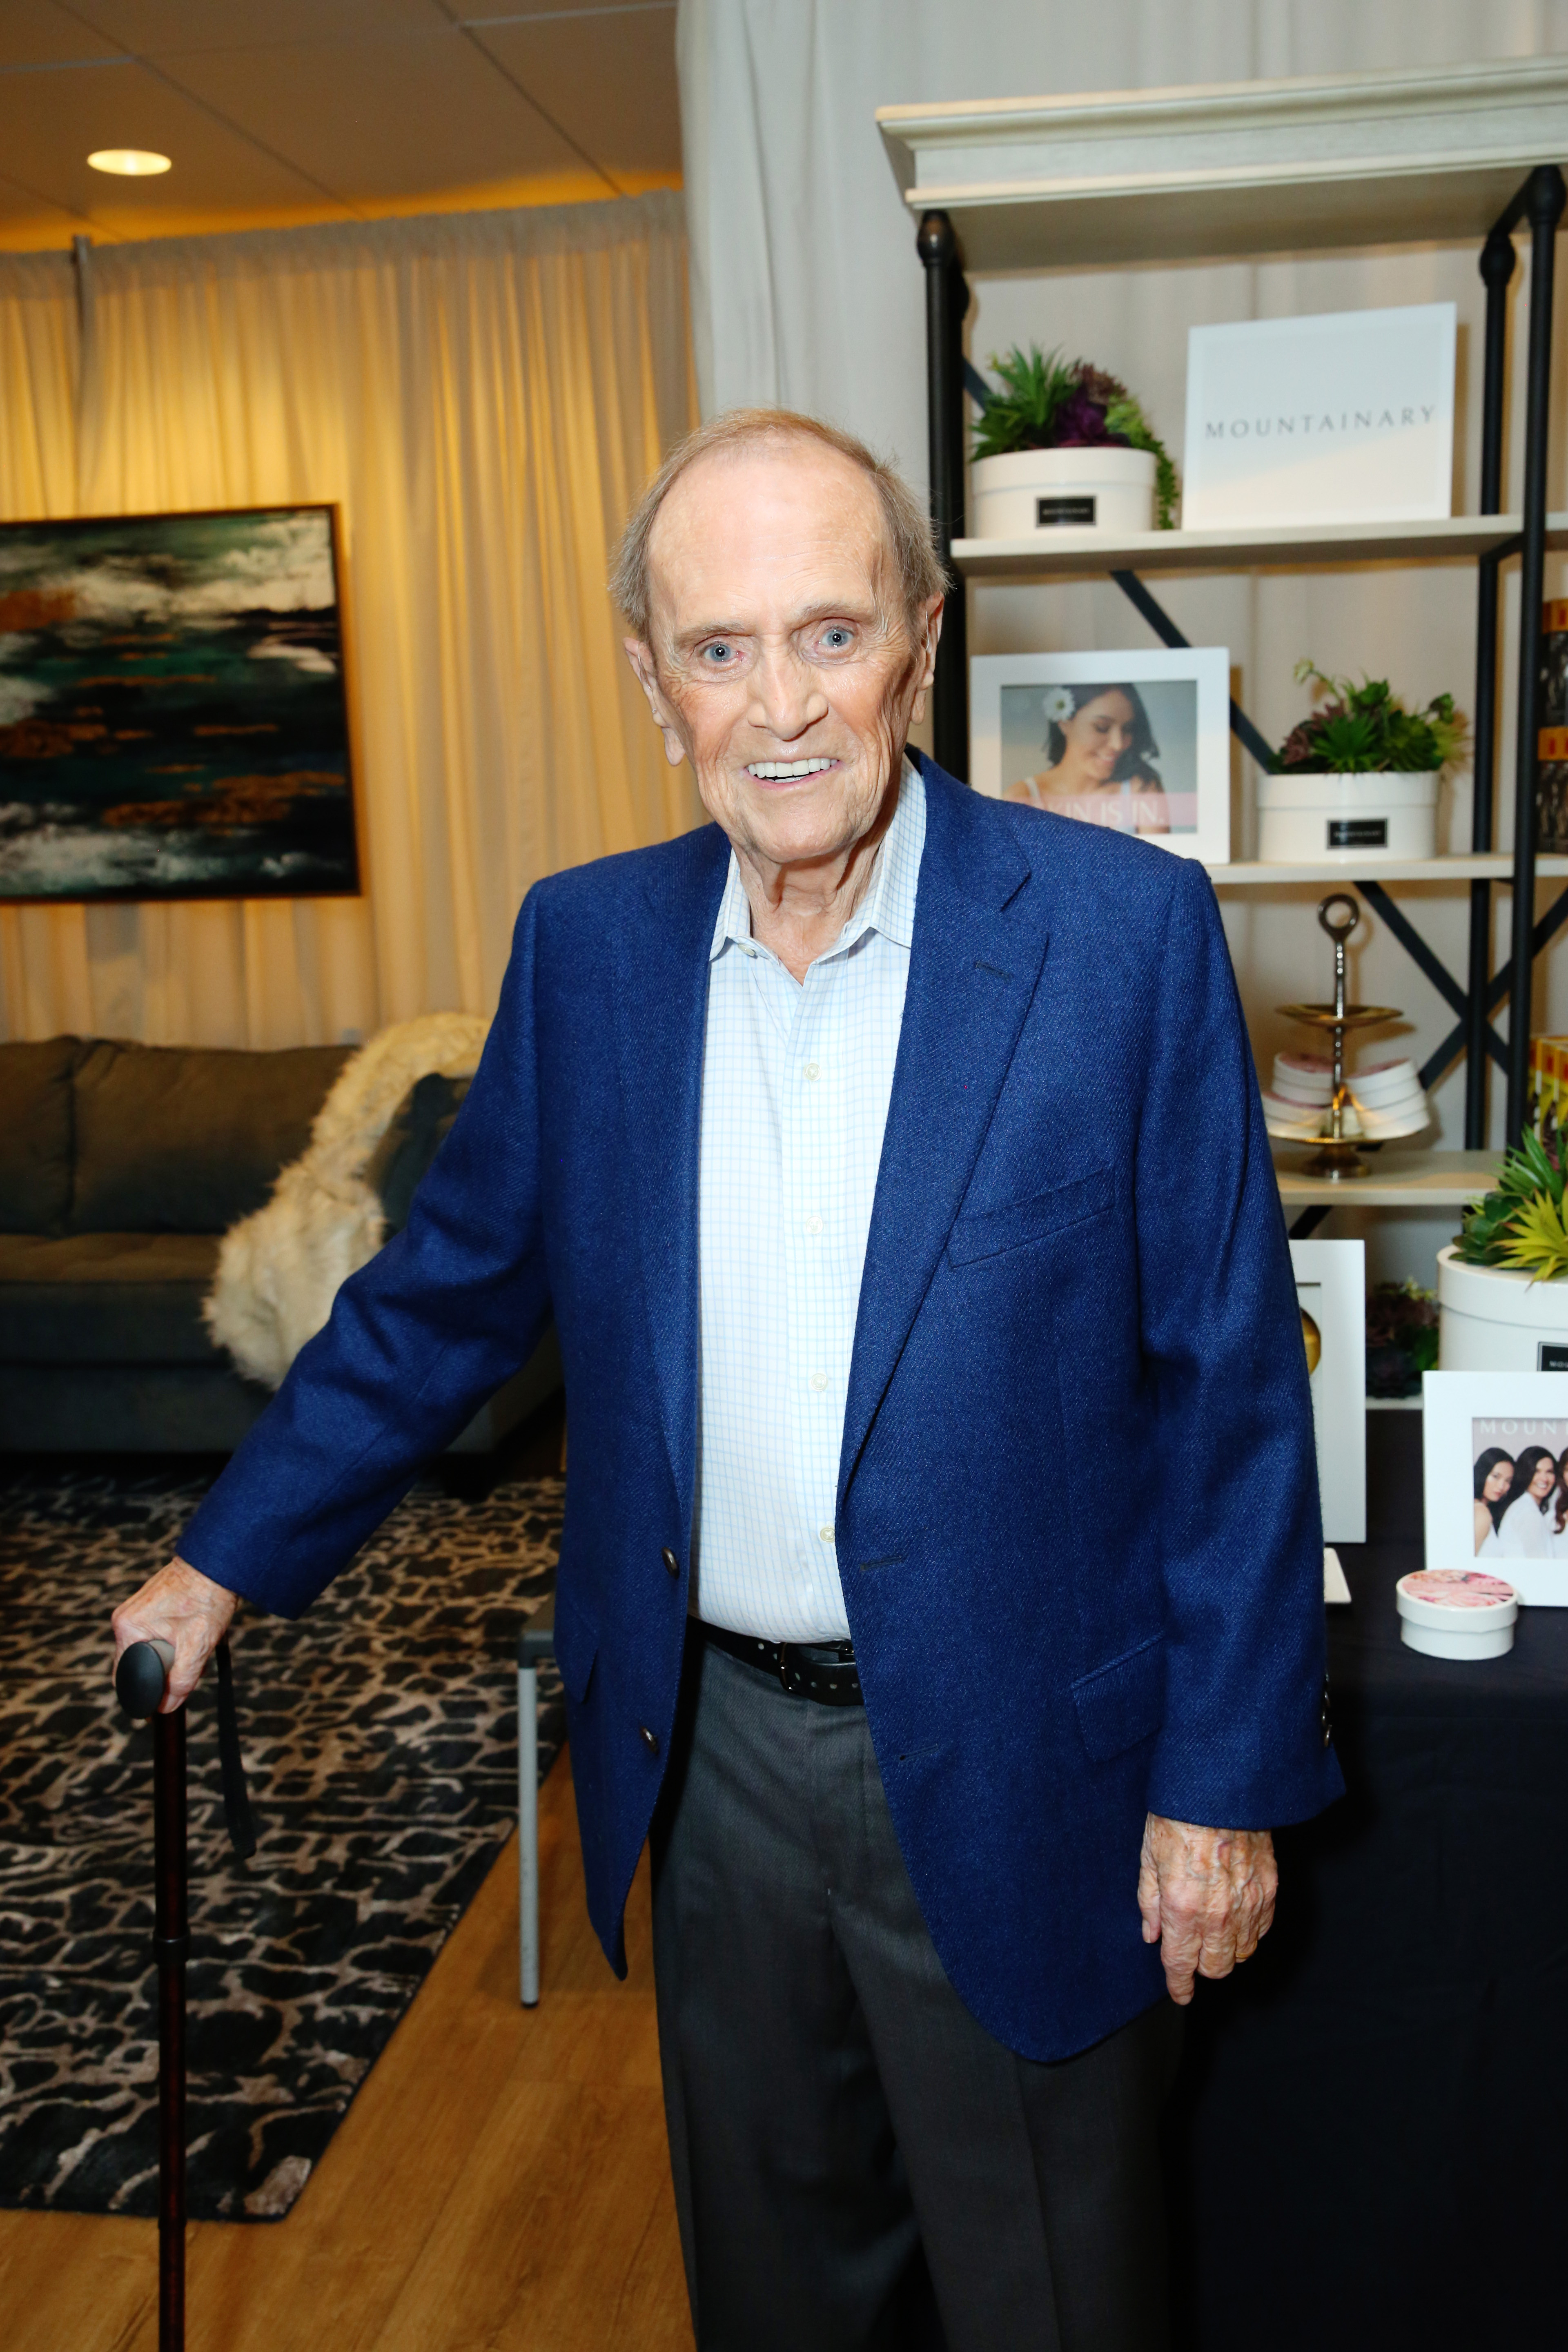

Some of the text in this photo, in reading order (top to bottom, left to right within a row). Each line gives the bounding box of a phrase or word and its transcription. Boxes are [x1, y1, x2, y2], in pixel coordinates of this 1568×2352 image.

[1205, 404, 1436, 439] MOUNTAINARY
[1100, 800, 1125, 824] IS
[1131, 799, 1165, 824] IN.
[1479, 1419, 1568, 1435] MOUN
